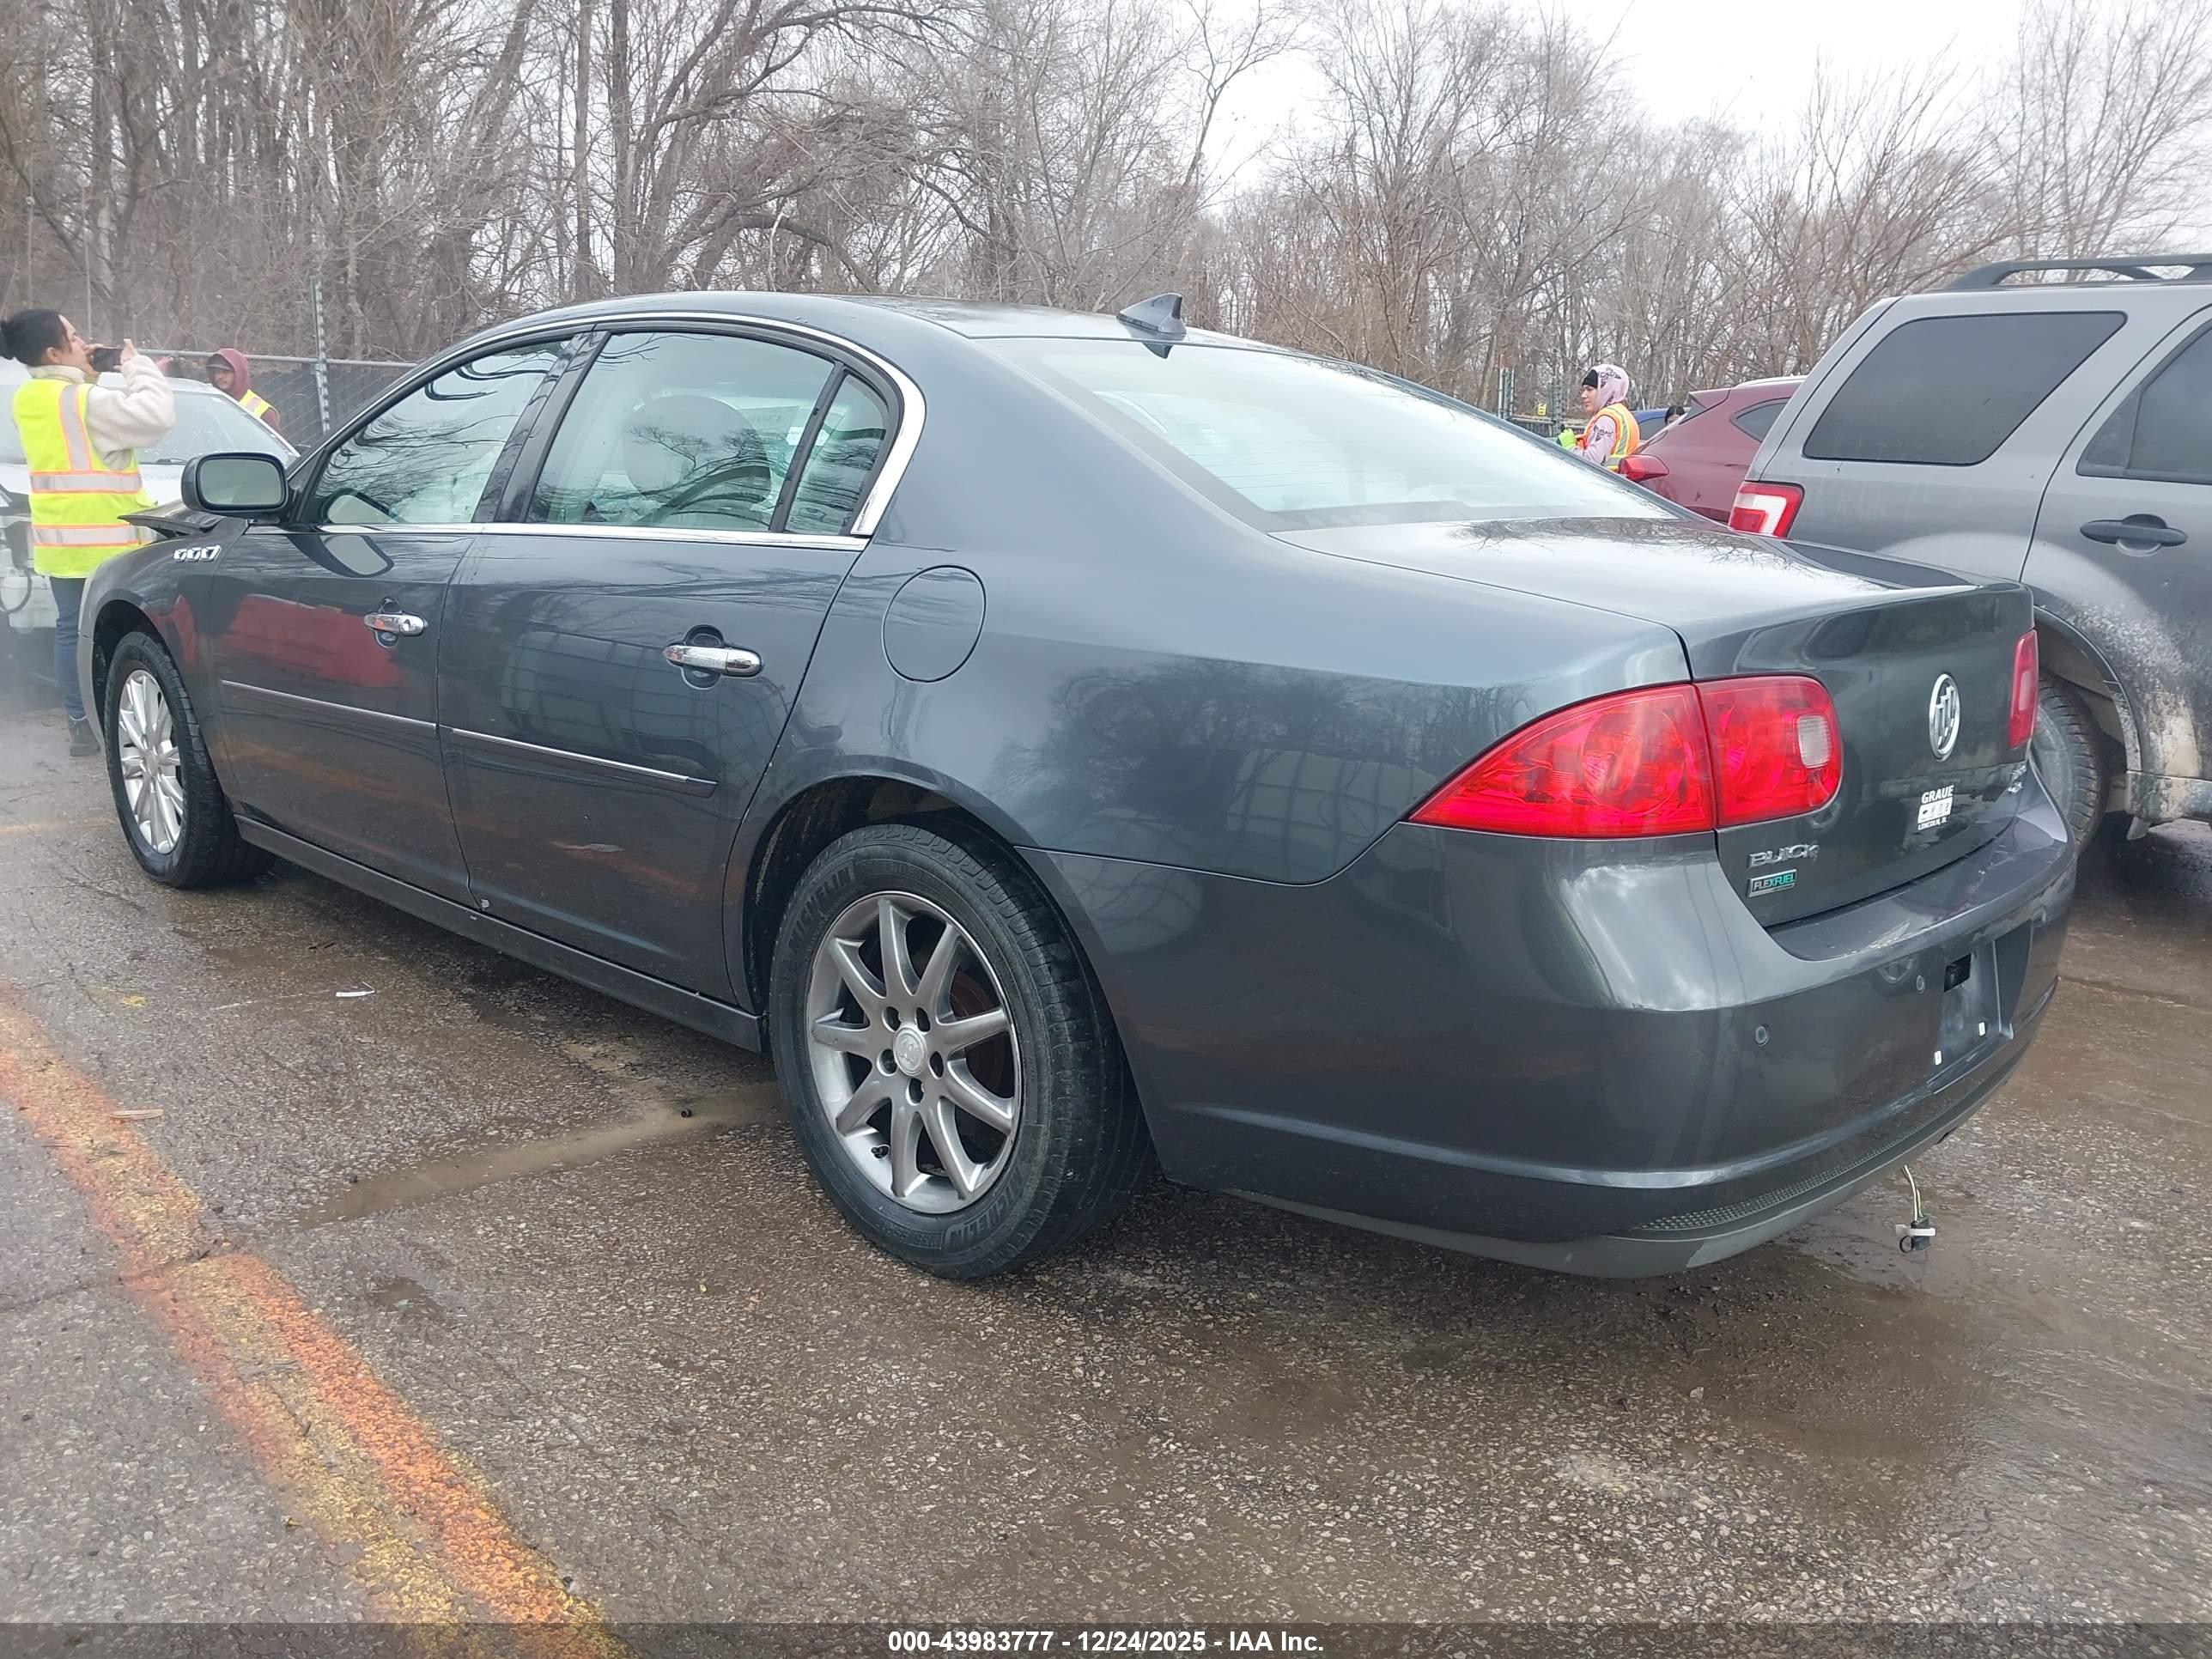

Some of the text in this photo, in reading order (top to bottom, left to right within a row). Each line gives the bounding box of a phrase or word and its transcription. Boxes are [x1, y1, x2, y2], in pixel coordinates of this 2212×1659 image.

[1921, 784, 1954, 805] GRAUE
[1748, 843, 1820, 867] BUICK
[1753, 872, 1795, 891] FLEXFUEL
[787, 857, 857, 953] MICHELIN
